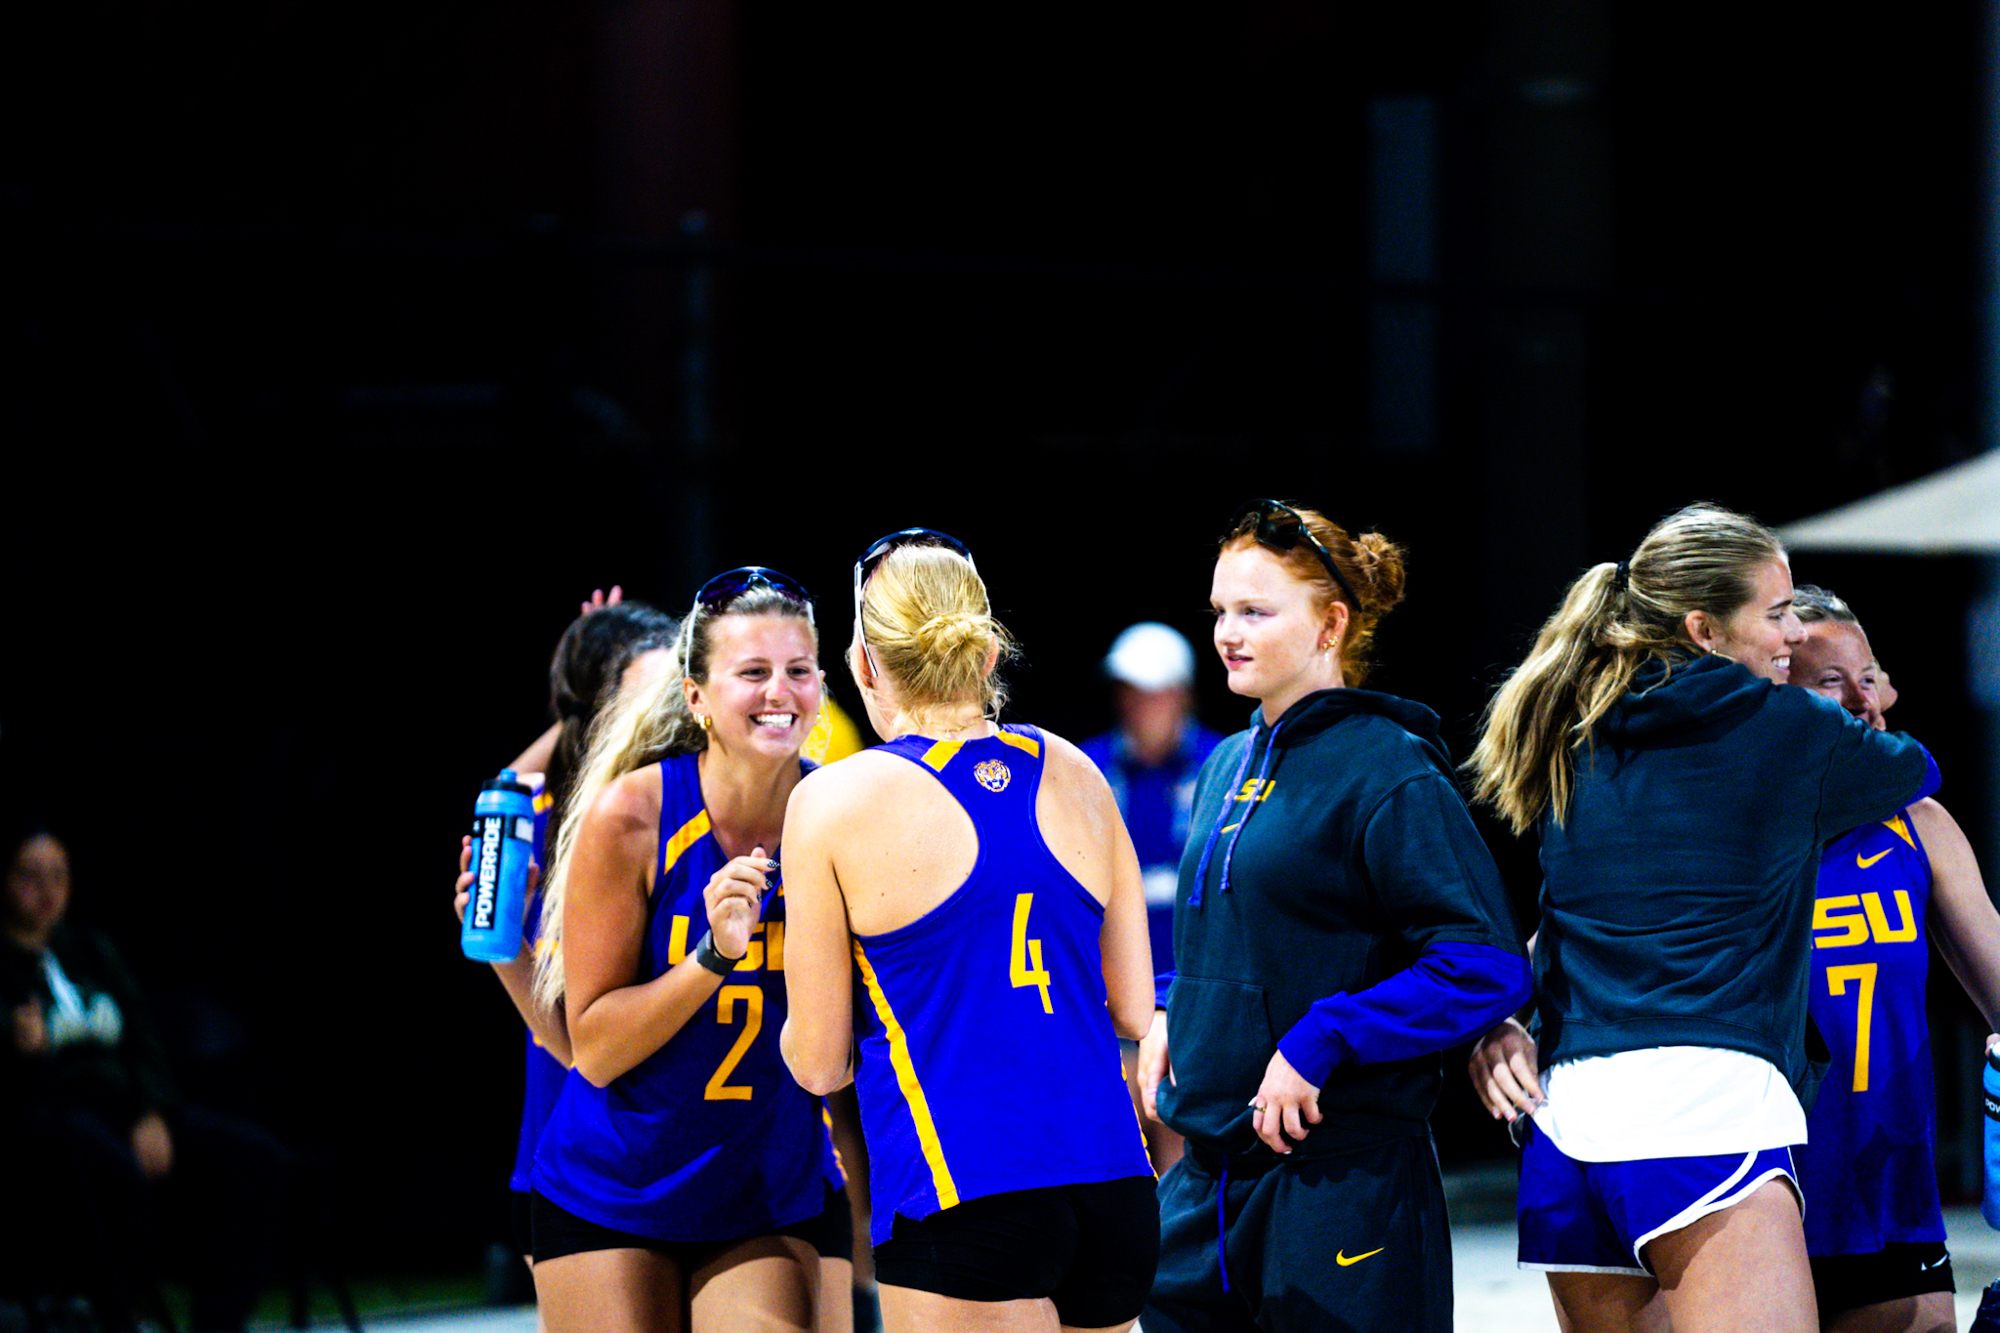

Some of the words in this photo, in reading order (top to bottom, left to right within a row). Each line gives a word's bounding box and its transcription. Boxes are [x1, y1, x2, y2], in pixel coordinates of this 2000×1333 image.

[1224, 778, 1276, 802] SU
[474, 816, 502, 928] POWERADE
[1811, 889, 1918, 949] SU
[1009, 892, 1054, 1015] 4
[703, 984, 764, 1101] 2
[1826, 962, 1878, 1093] 7
